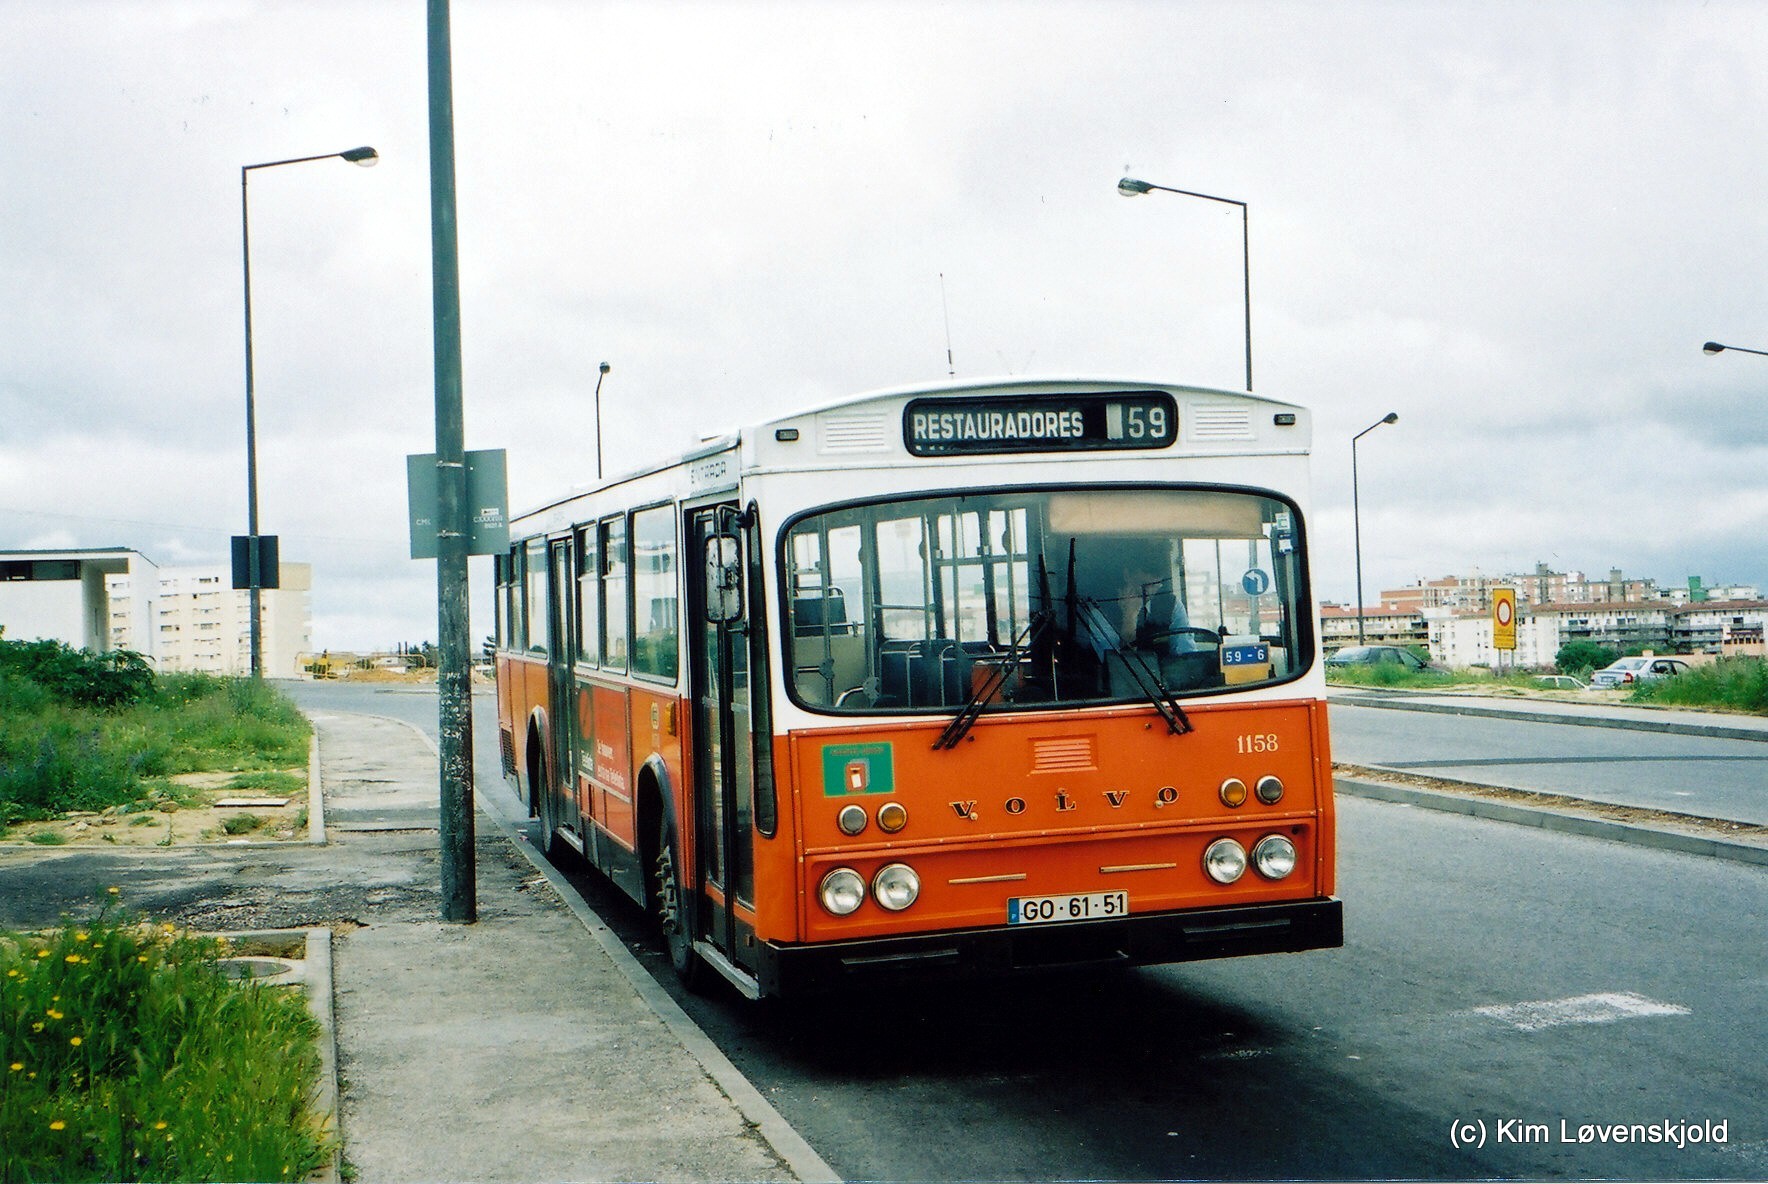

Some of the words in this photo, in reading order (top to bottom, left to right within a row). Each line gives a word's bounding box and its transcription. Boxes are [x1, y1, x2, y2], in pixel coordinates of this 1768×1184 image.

[913, 411, 1084, 440] RESTAURADORES
[1128, 405, 1167, 438] 59
[691, 461, 727, 484] ERADA
[1237, 733, 1279, 754] 1158
[949, 786, 1179, 819] VOLVO
